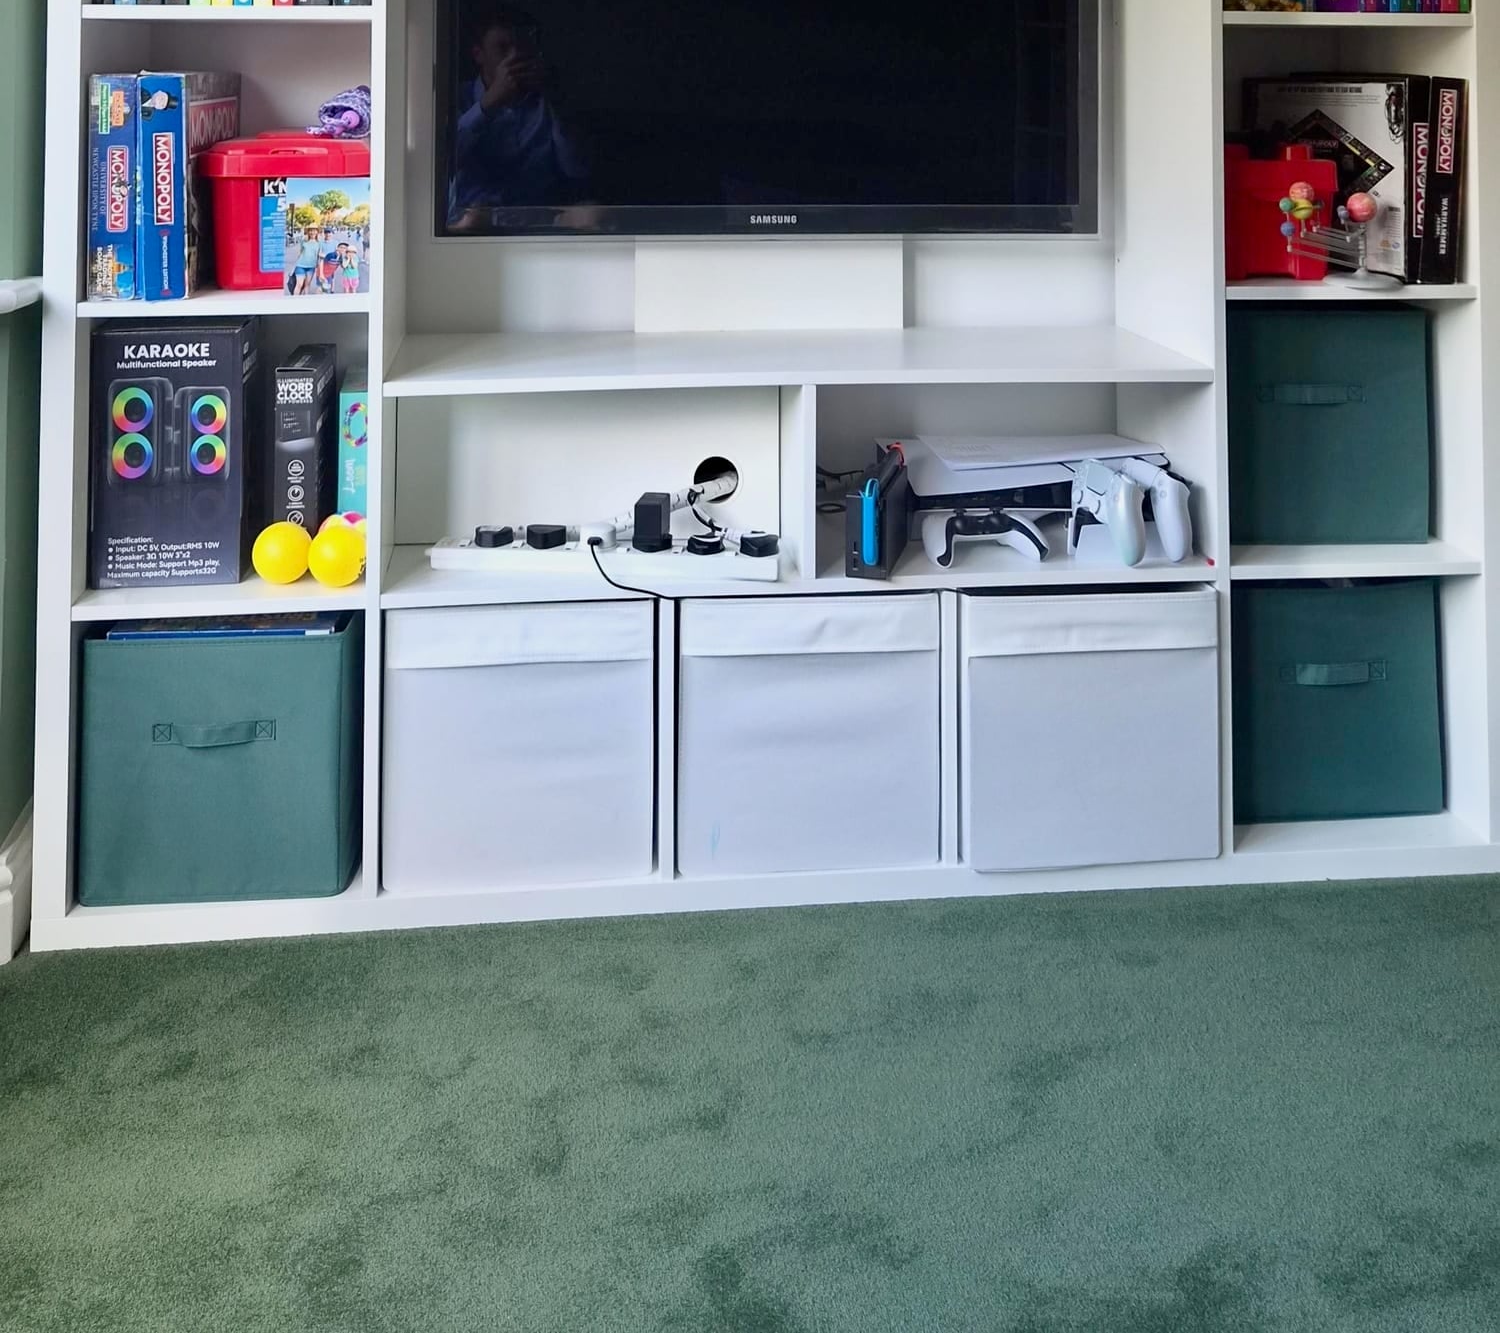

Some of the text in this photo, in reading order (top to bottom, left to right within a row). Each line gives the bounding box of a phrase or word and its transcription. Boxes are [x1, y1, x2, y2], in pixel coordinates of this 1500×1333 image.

[1440, 92, 1454, 171] MONOPOLY
[155, 136, 171, 222] MONOPOLY
[750, 214, 798, 225] SAMSUNG
[1439, 198, 1448, 255] WARHAMMER
[124, 343, 210, 359] KARAOKE
[116, 359, 217, 370] Multifunctional Speaker
[277, 383, 313, 392] WORD
[277, 391, 313, 400] CLOCK
[108, 536, 154, 544] Specification:
[137, 544, 148, 552] DC
[115, 554, 144, 562] Speaker:
[115, 559, 204, 570] Music Mode: Support Mp3
[107, 571, 140, 579] Maximum
